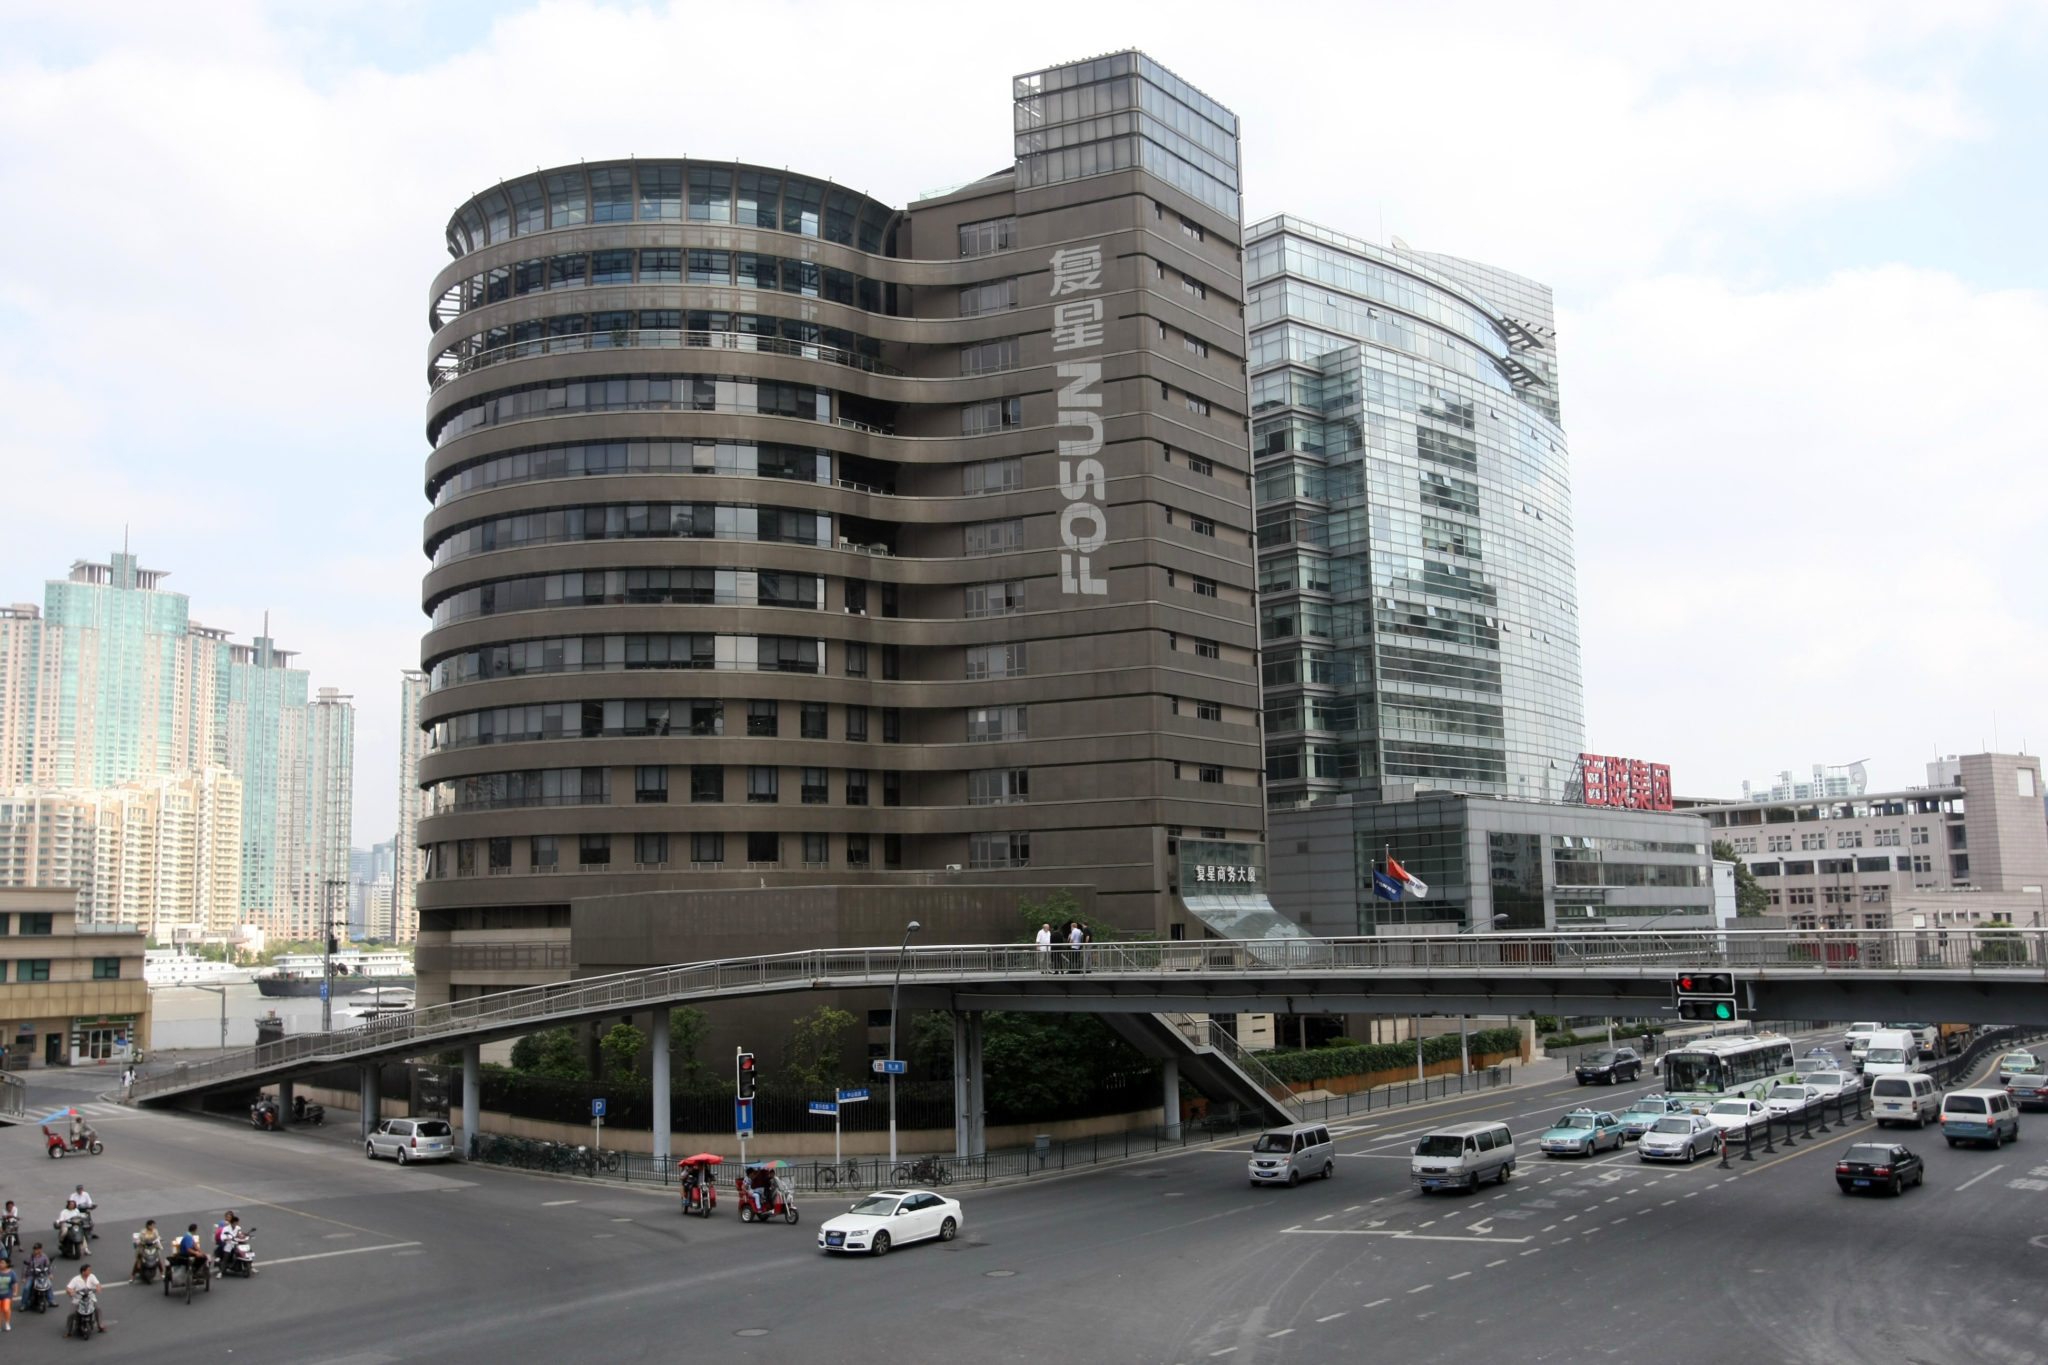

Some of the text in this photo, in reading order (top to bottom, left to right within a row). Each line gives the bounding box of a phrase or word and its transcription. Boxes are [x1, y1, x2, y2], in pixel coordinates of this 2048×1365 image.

[1049, 244, 1104, 353] 复星
[1056, 360, 1108, 596] FOSUN
[1581, 753, 1673, 811] 百联集团
[1195, 864, 1257, 882] 复星商务大厦
